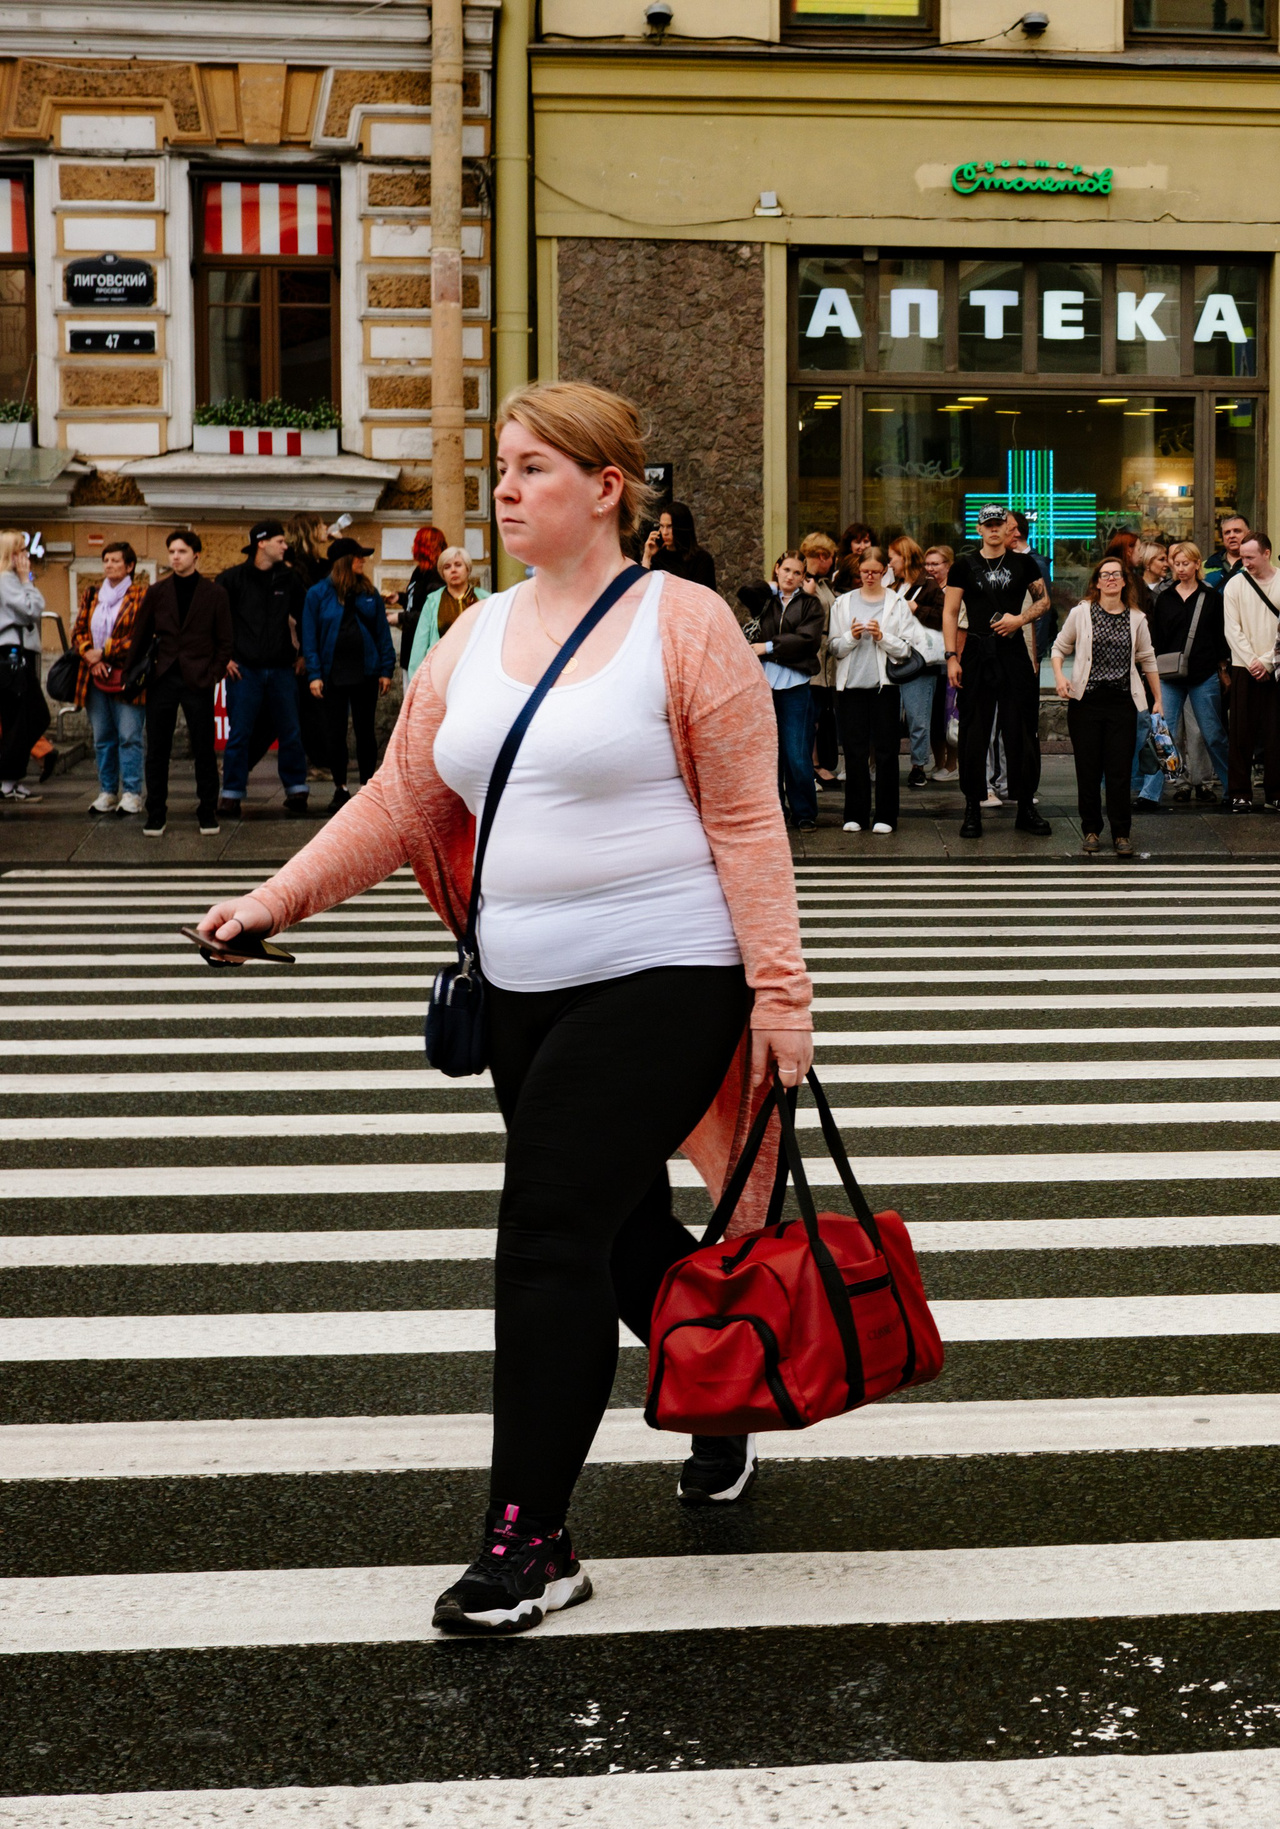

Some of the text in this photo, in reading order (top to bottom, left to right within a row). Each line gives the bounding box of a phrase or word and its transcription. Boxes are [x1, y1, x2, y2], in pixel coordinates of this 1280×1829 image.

[73, 271, 147, 287] ЛИГОВСКИЙ
[805, 287, 1249, 343] АПТЕКА
[105, 333, 120, 348] 47
